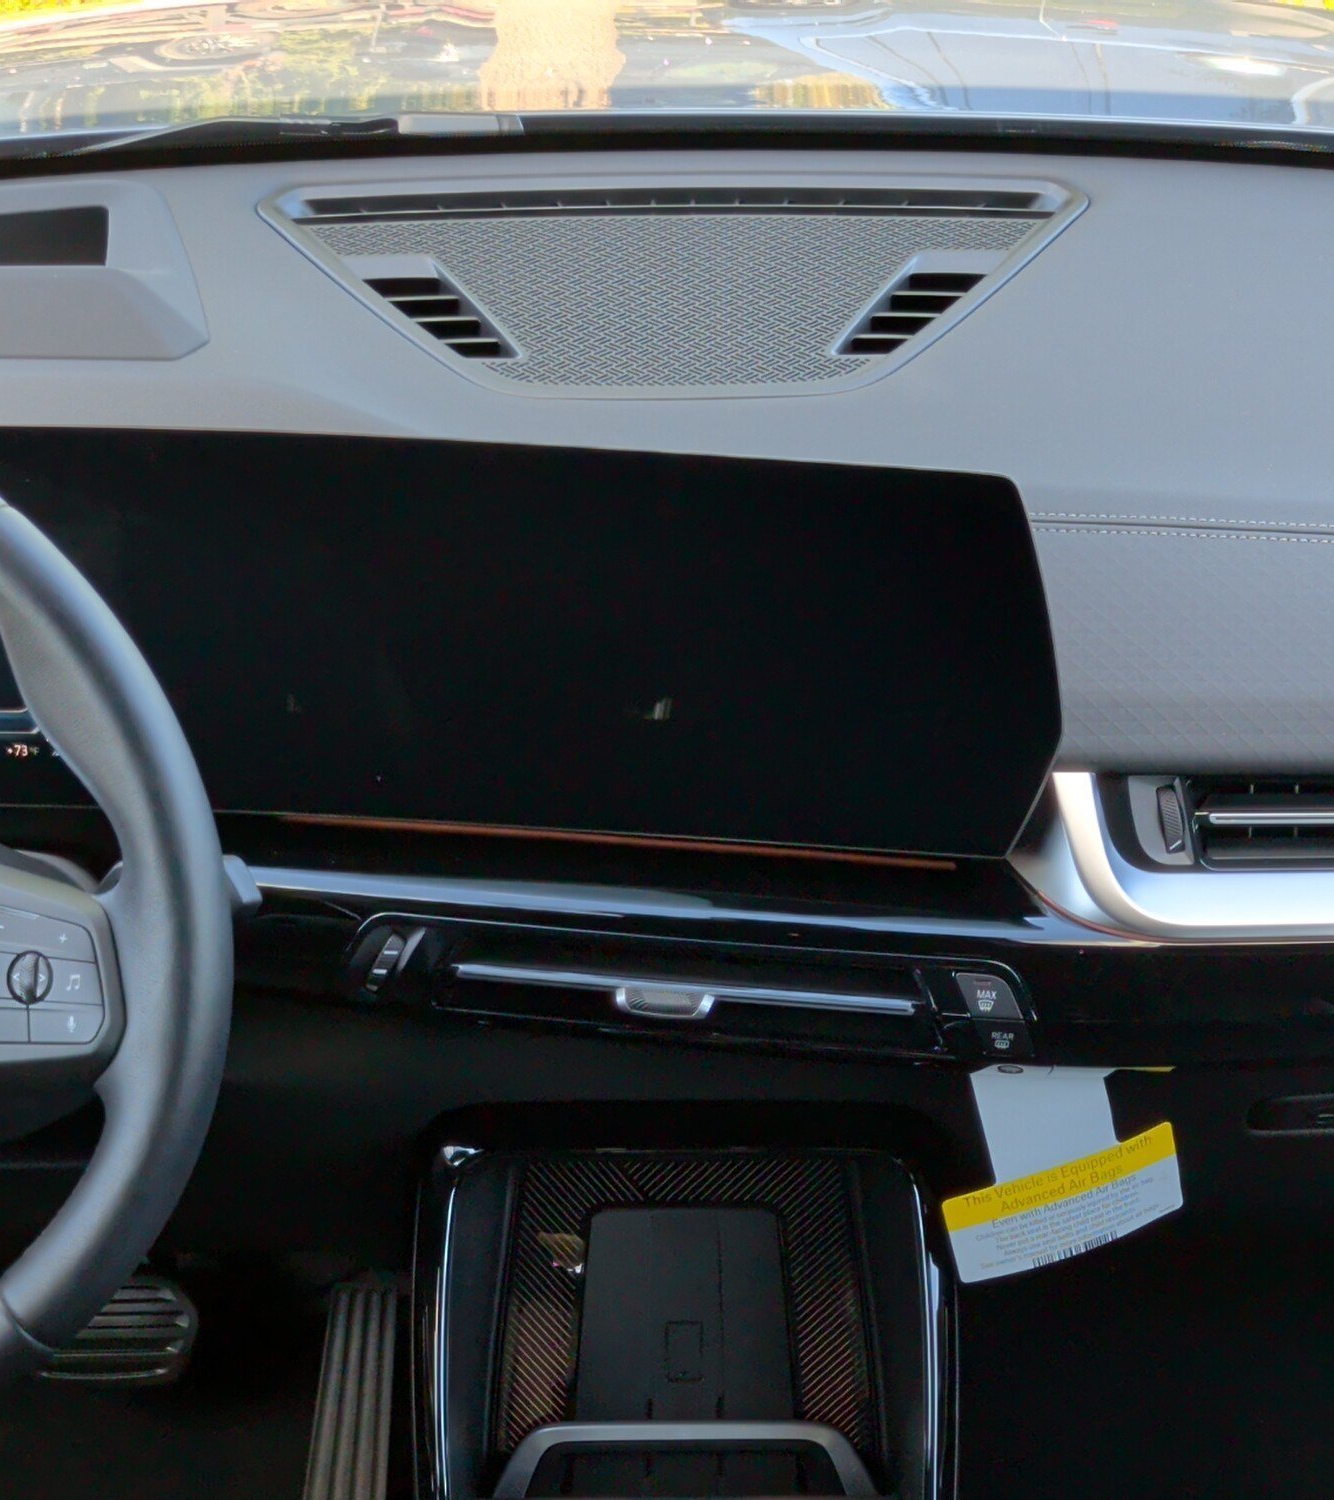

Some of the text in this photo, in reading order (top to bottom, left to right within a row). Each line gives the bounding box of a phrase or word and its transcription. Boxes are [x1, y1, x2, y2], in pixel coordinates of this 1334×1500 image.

[976, 989, 997, 999] MAX
[990, 1032, 1015, 1040] REAR
[963, 1135, 1153, 1208] This Vehicle is Equipped with
[998, 1164, 1124, 1213] Advanced Air Bags
[991, 1174, 1137, 1228] Even with Advanced Air Bags
